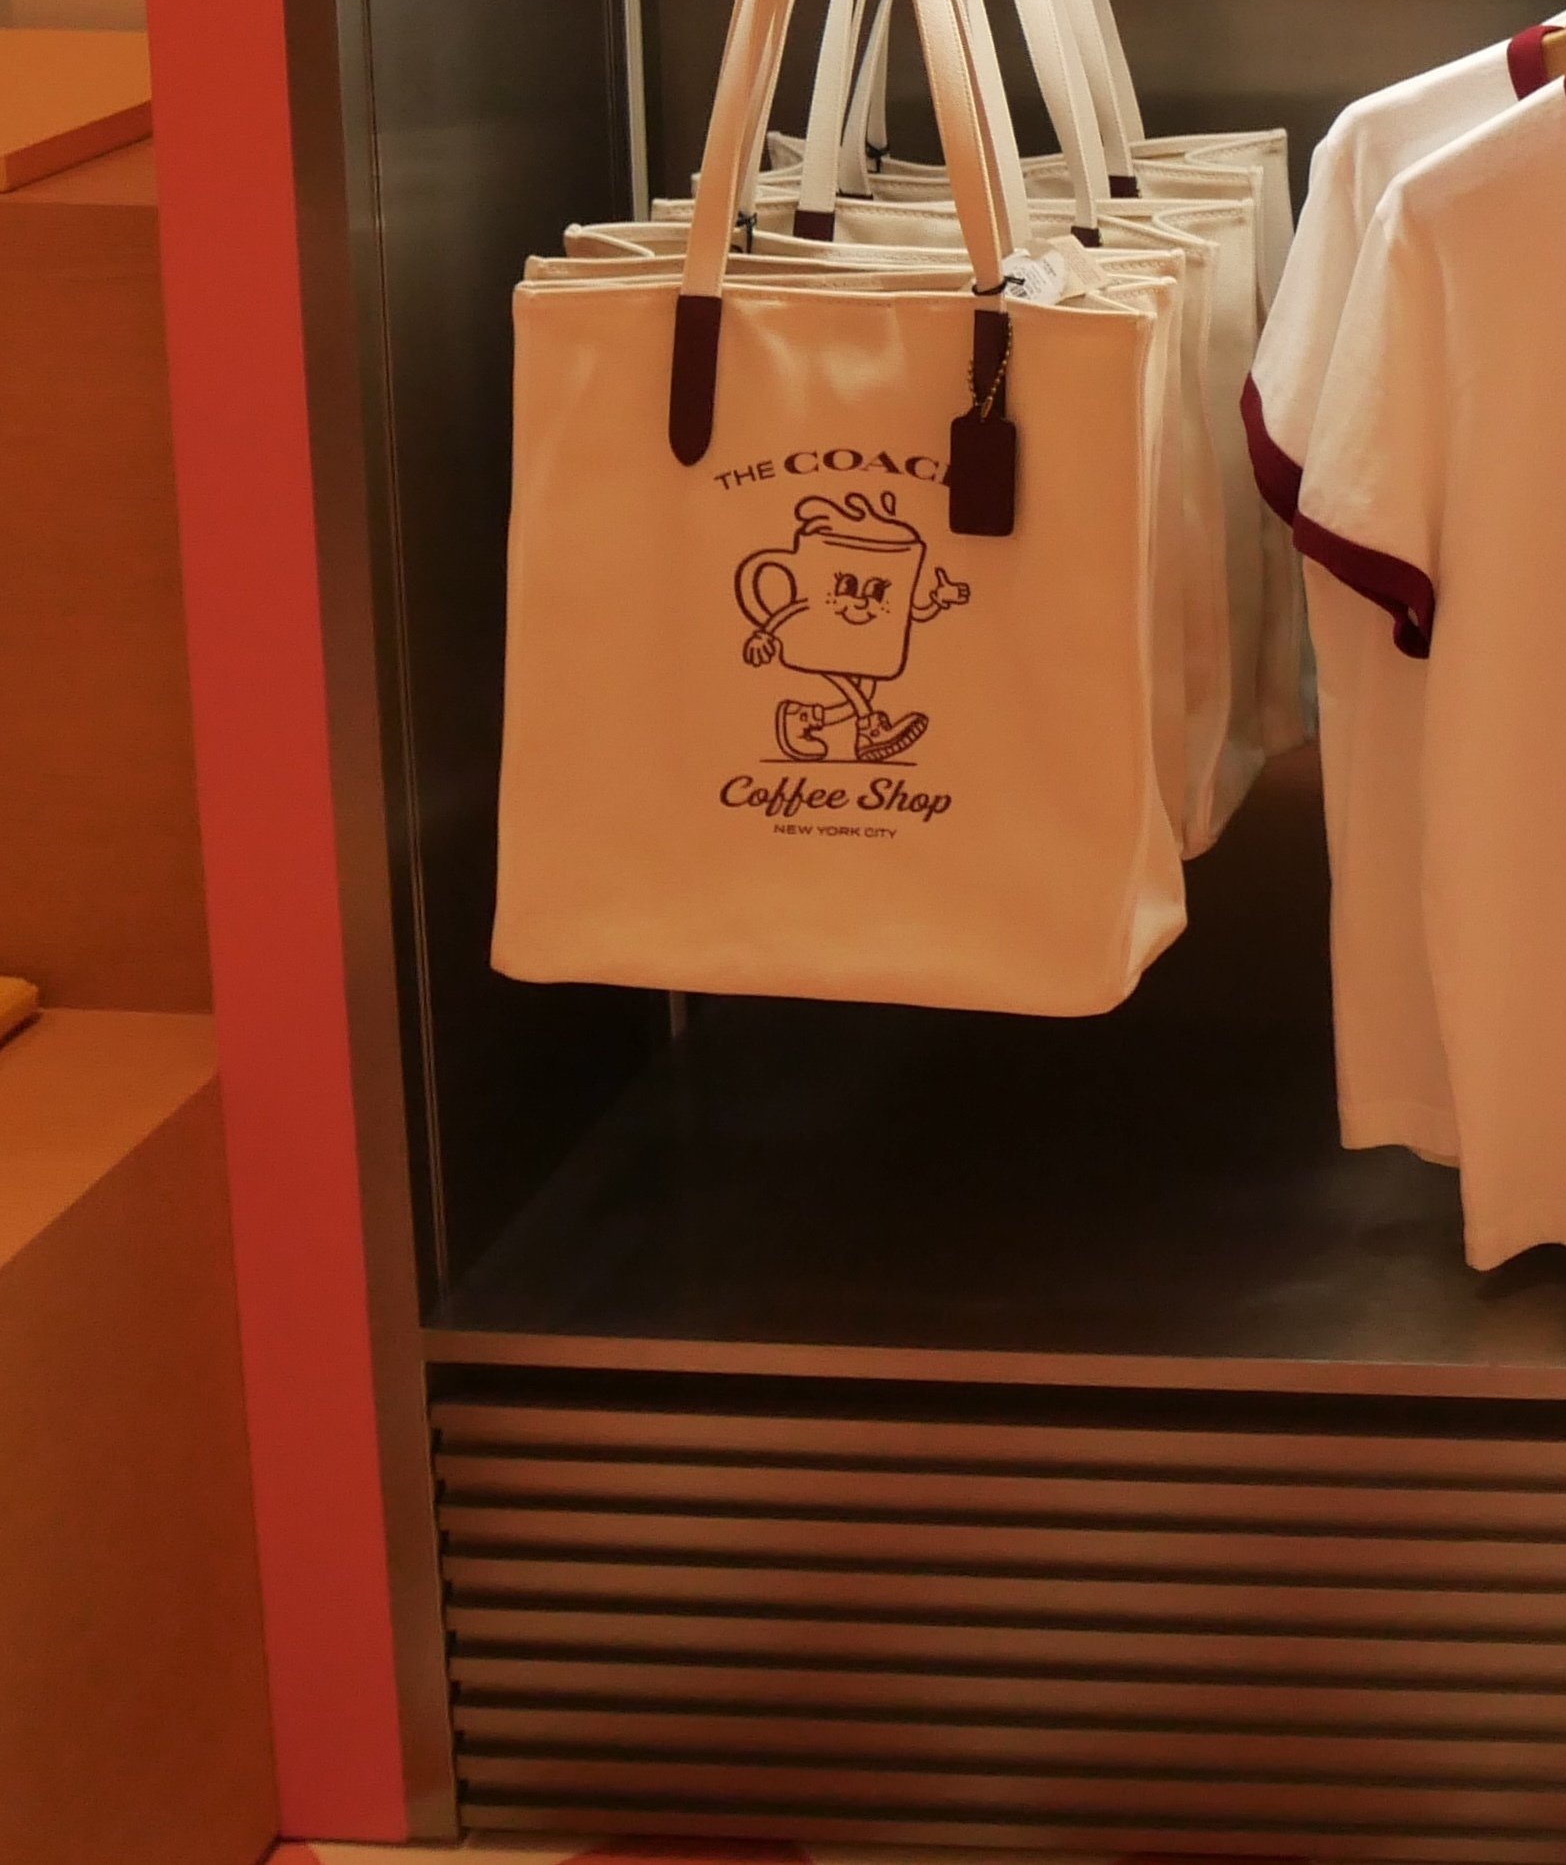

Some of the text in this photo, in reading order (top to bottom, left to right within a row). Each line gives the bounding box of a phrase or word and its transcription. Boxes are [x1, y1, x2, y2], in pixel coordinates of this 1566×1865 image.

[714, 448, 951, 490] THE COAC
[719, 775, 952, 822] Coffee Shop
[773, 823, 898, 839] NEW YORK CITY
